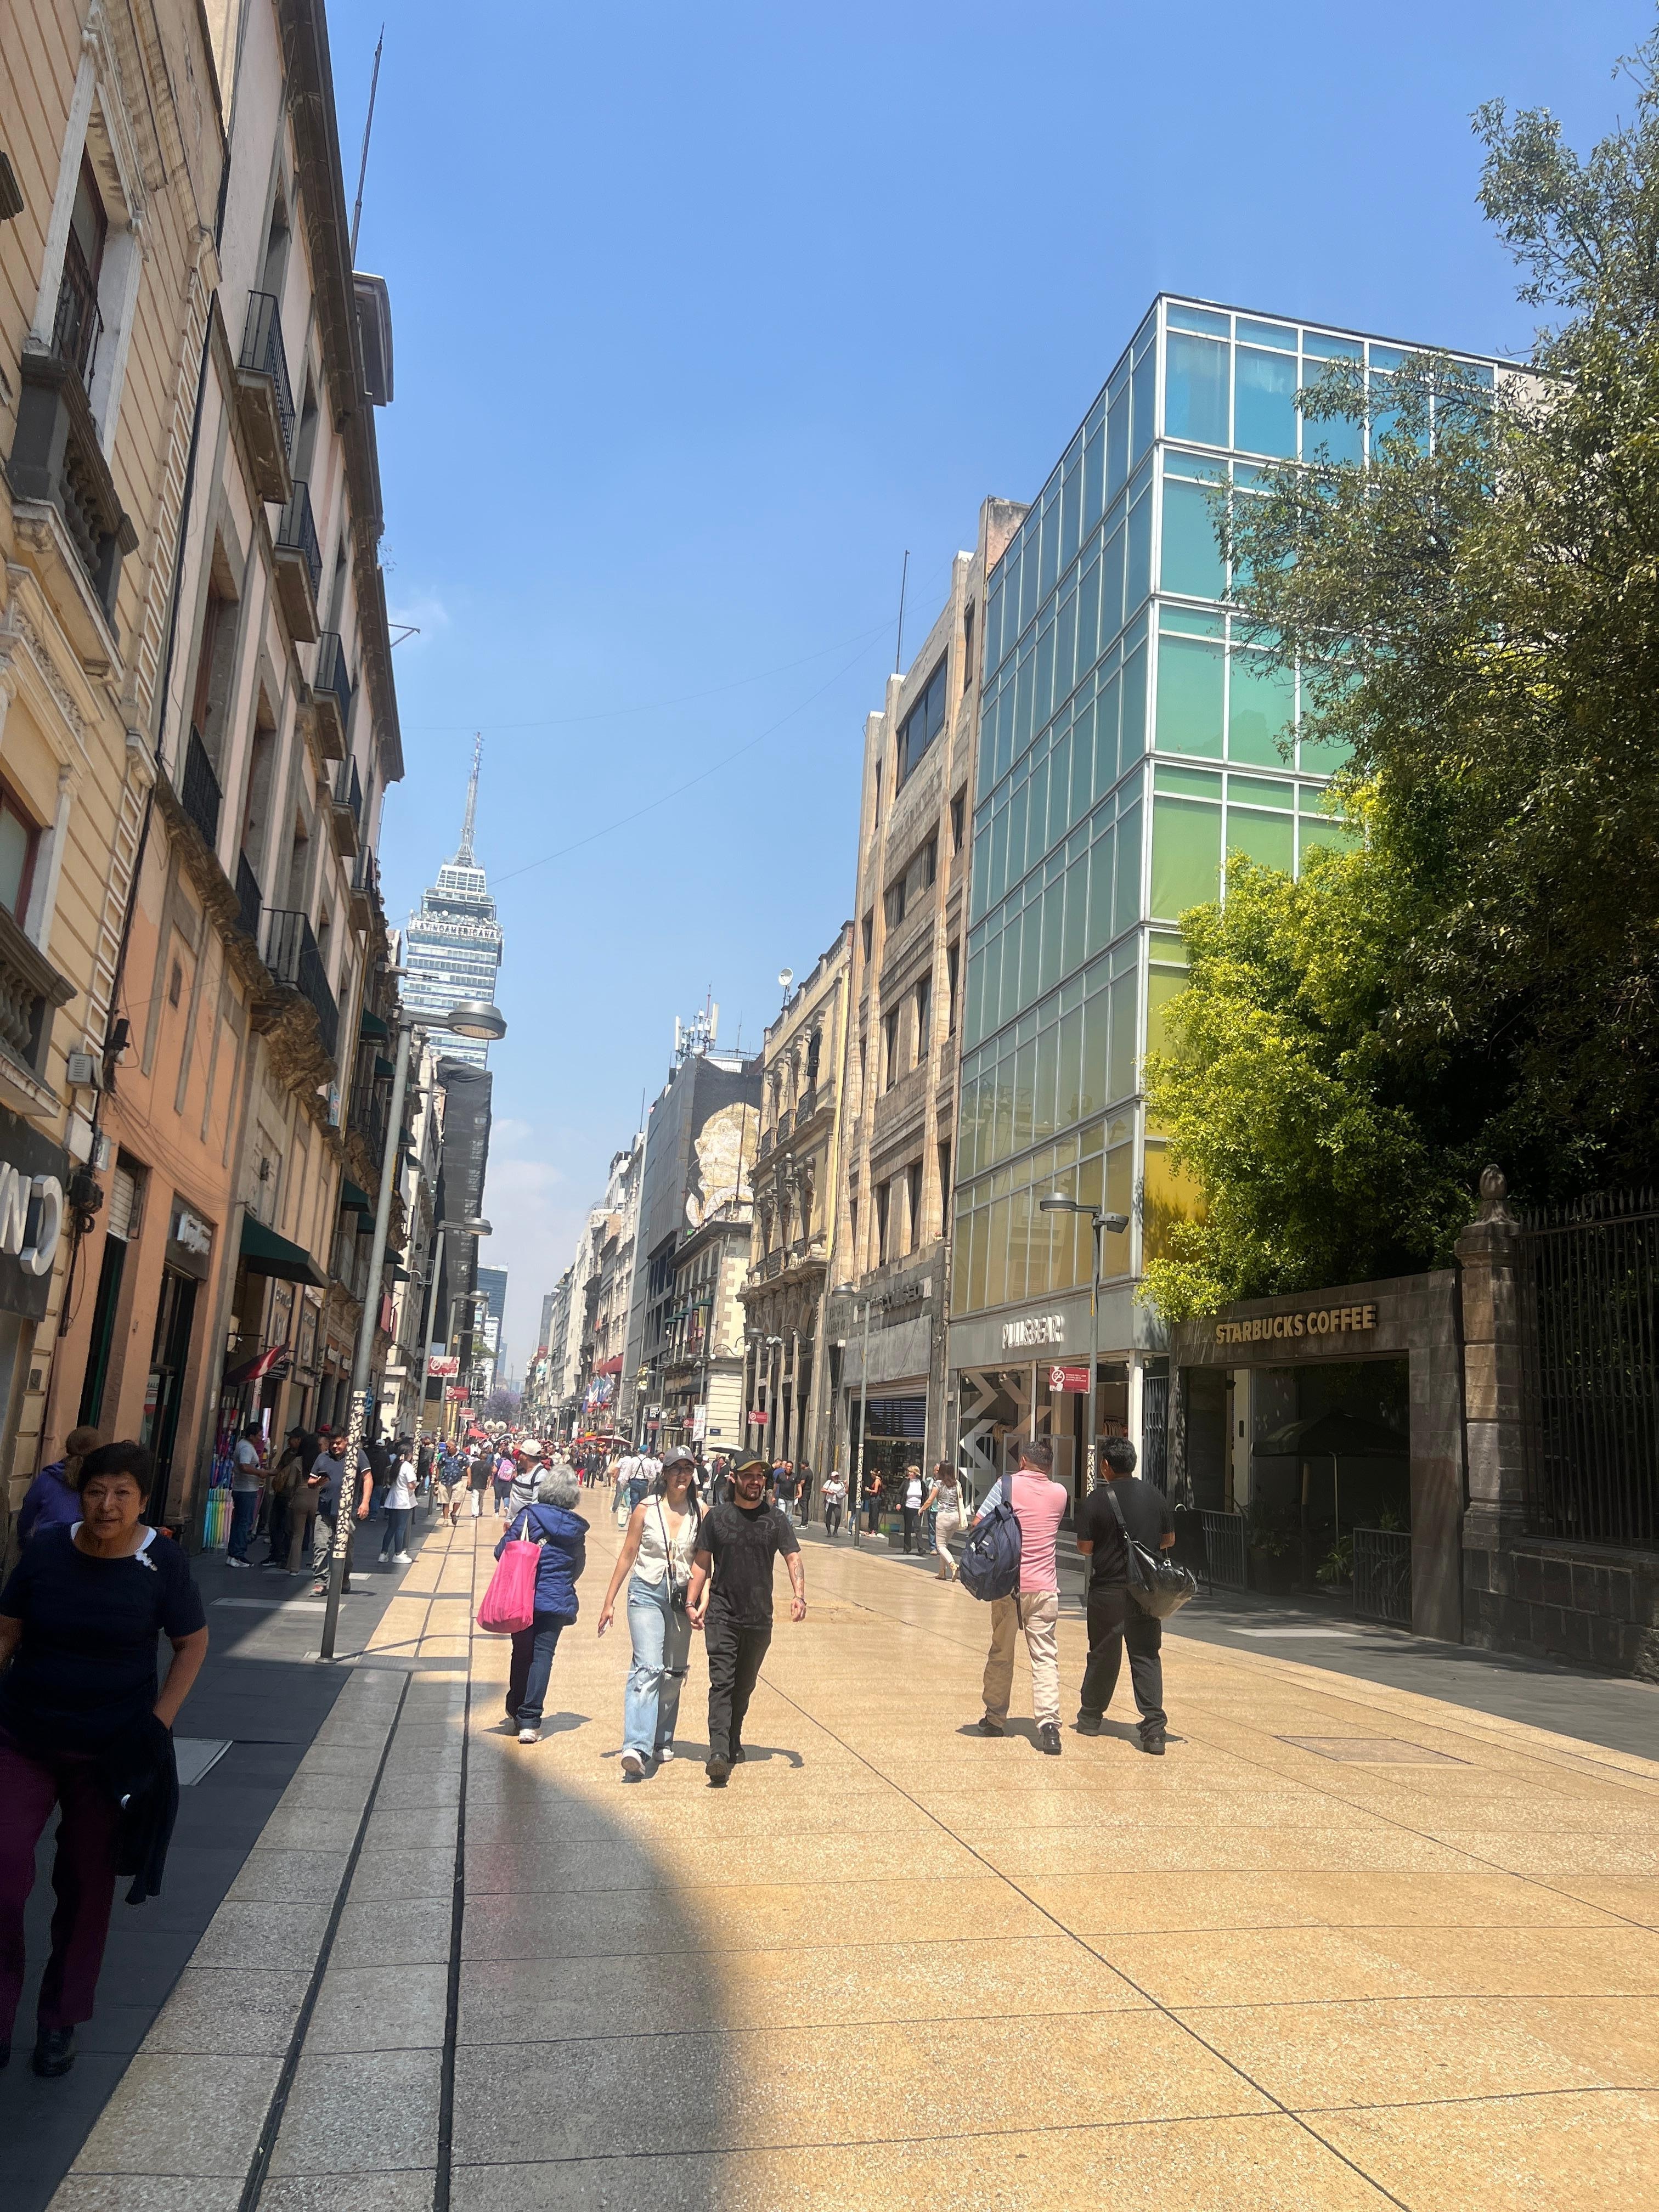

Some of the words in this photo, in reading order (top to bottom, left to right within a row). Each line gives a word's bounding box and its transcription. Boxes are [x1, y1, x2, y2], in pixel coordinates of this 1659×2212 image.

[414, 922, 496, 938] LATINOAMERICANA
[0, 1161, 63, 1276] NO
[1002, 1314, 1062, 1349] PULL&BEAR
[1216, 1314, 1303, 1344] STARBUCKS
[1307, 1305, 1376, 1335] COFFEE
